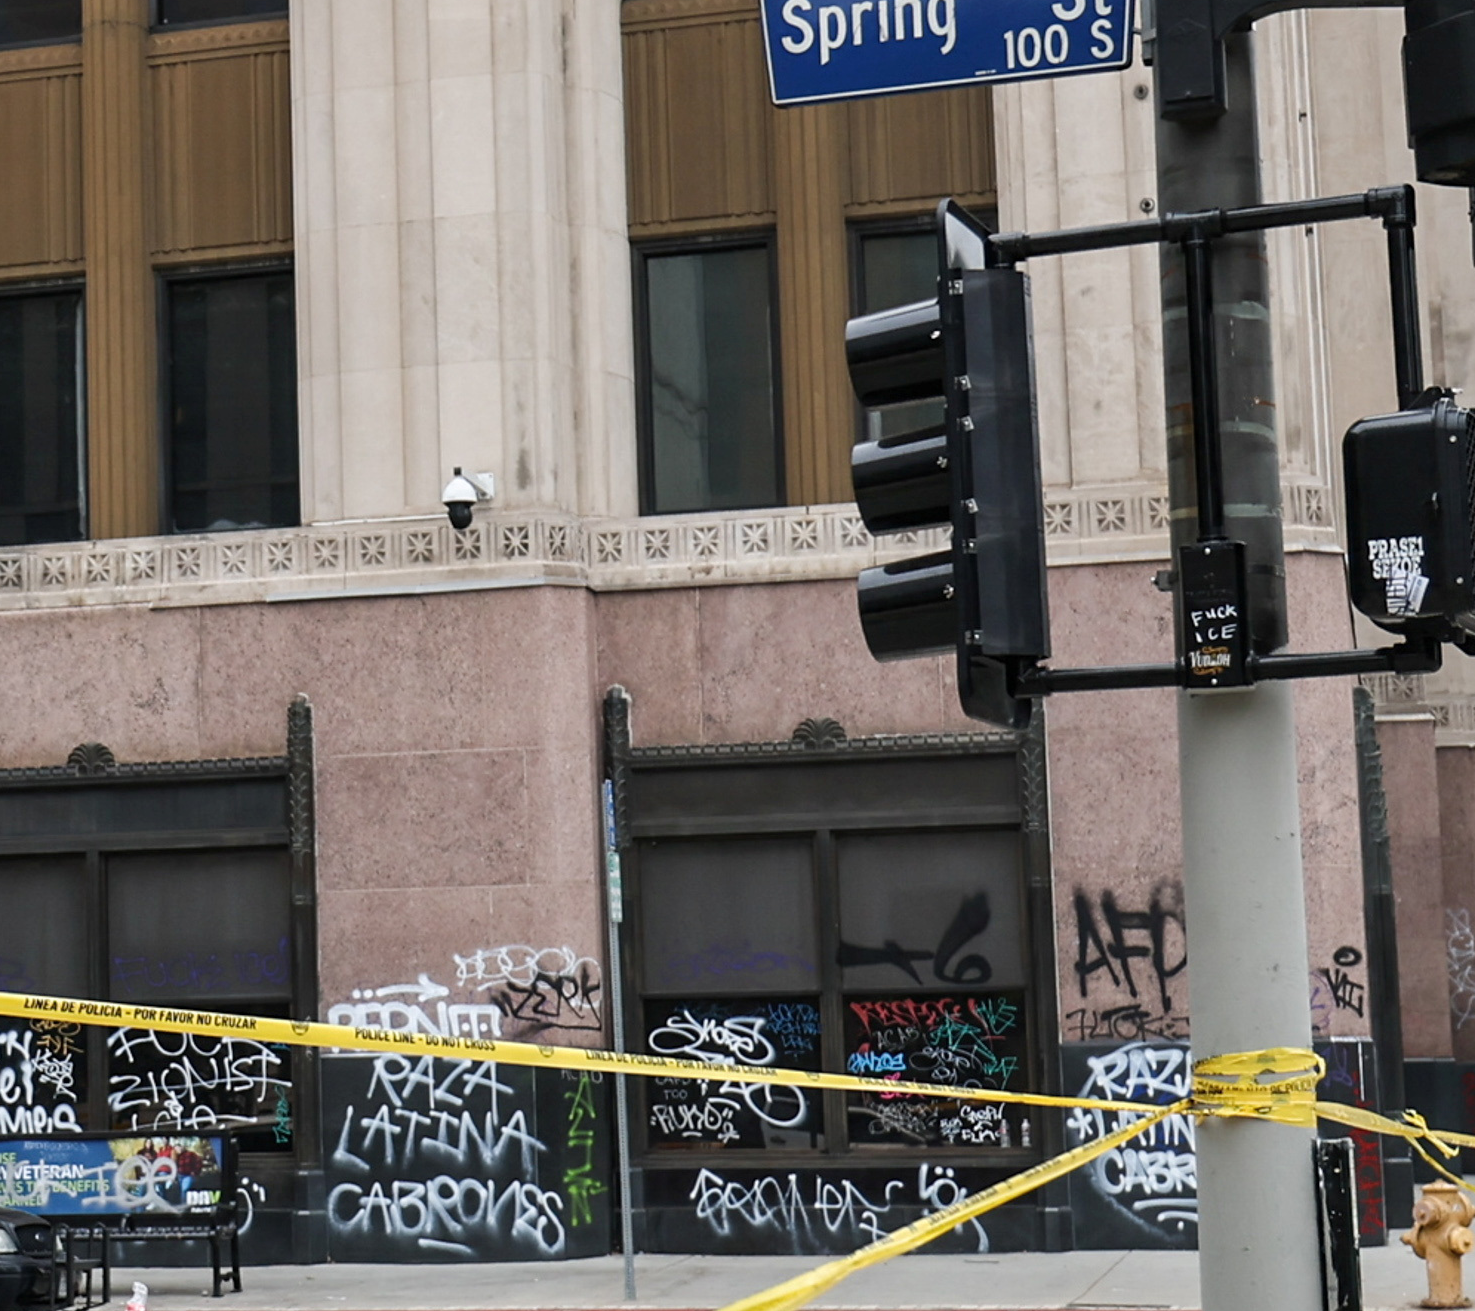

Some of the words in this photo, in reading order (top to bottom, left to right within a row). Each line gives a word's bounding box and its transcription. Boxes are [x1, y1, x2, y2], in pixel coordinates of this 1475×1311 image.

[1004, 24, 1069, 69] 100
[1089, 19, 1115, 59] S
[1191, 604, 1238, 627] FUCK
[24, 997, 58, 1011] LINEA
[60, 1001, 75, 1012] DE
[78, 1003, 122, 1018] POLICIA
[133, 1007, 156, 1020] POR
[159, 1010, 194, 1024] FAVOR
[197, 1013, 212, 1026] NO
[214, 1015, 257, 1029] CRUZAR
[354, 1028, 389, 1042] POLICE
[392, 1032, 416, 1044] LINE
[464, 1039, 496, 1051] CROSS
[366, 1053, 514, 1126] RAZA
[1087, 1048, 1191, 1101] RAZ
[333, 1104, 547, 1175] LATINA
[1092, 1094, 1196, 1151] LATIN
[13, 1164, 84, 1180] VETERAN
[53, 1179, 110, 1192] BENEFITS
[1103, 1148, 1197, 1194] CABR
[3, 1196, 44, 1207] ARNED
[328, 1175, 565, 1255] CABRONES
